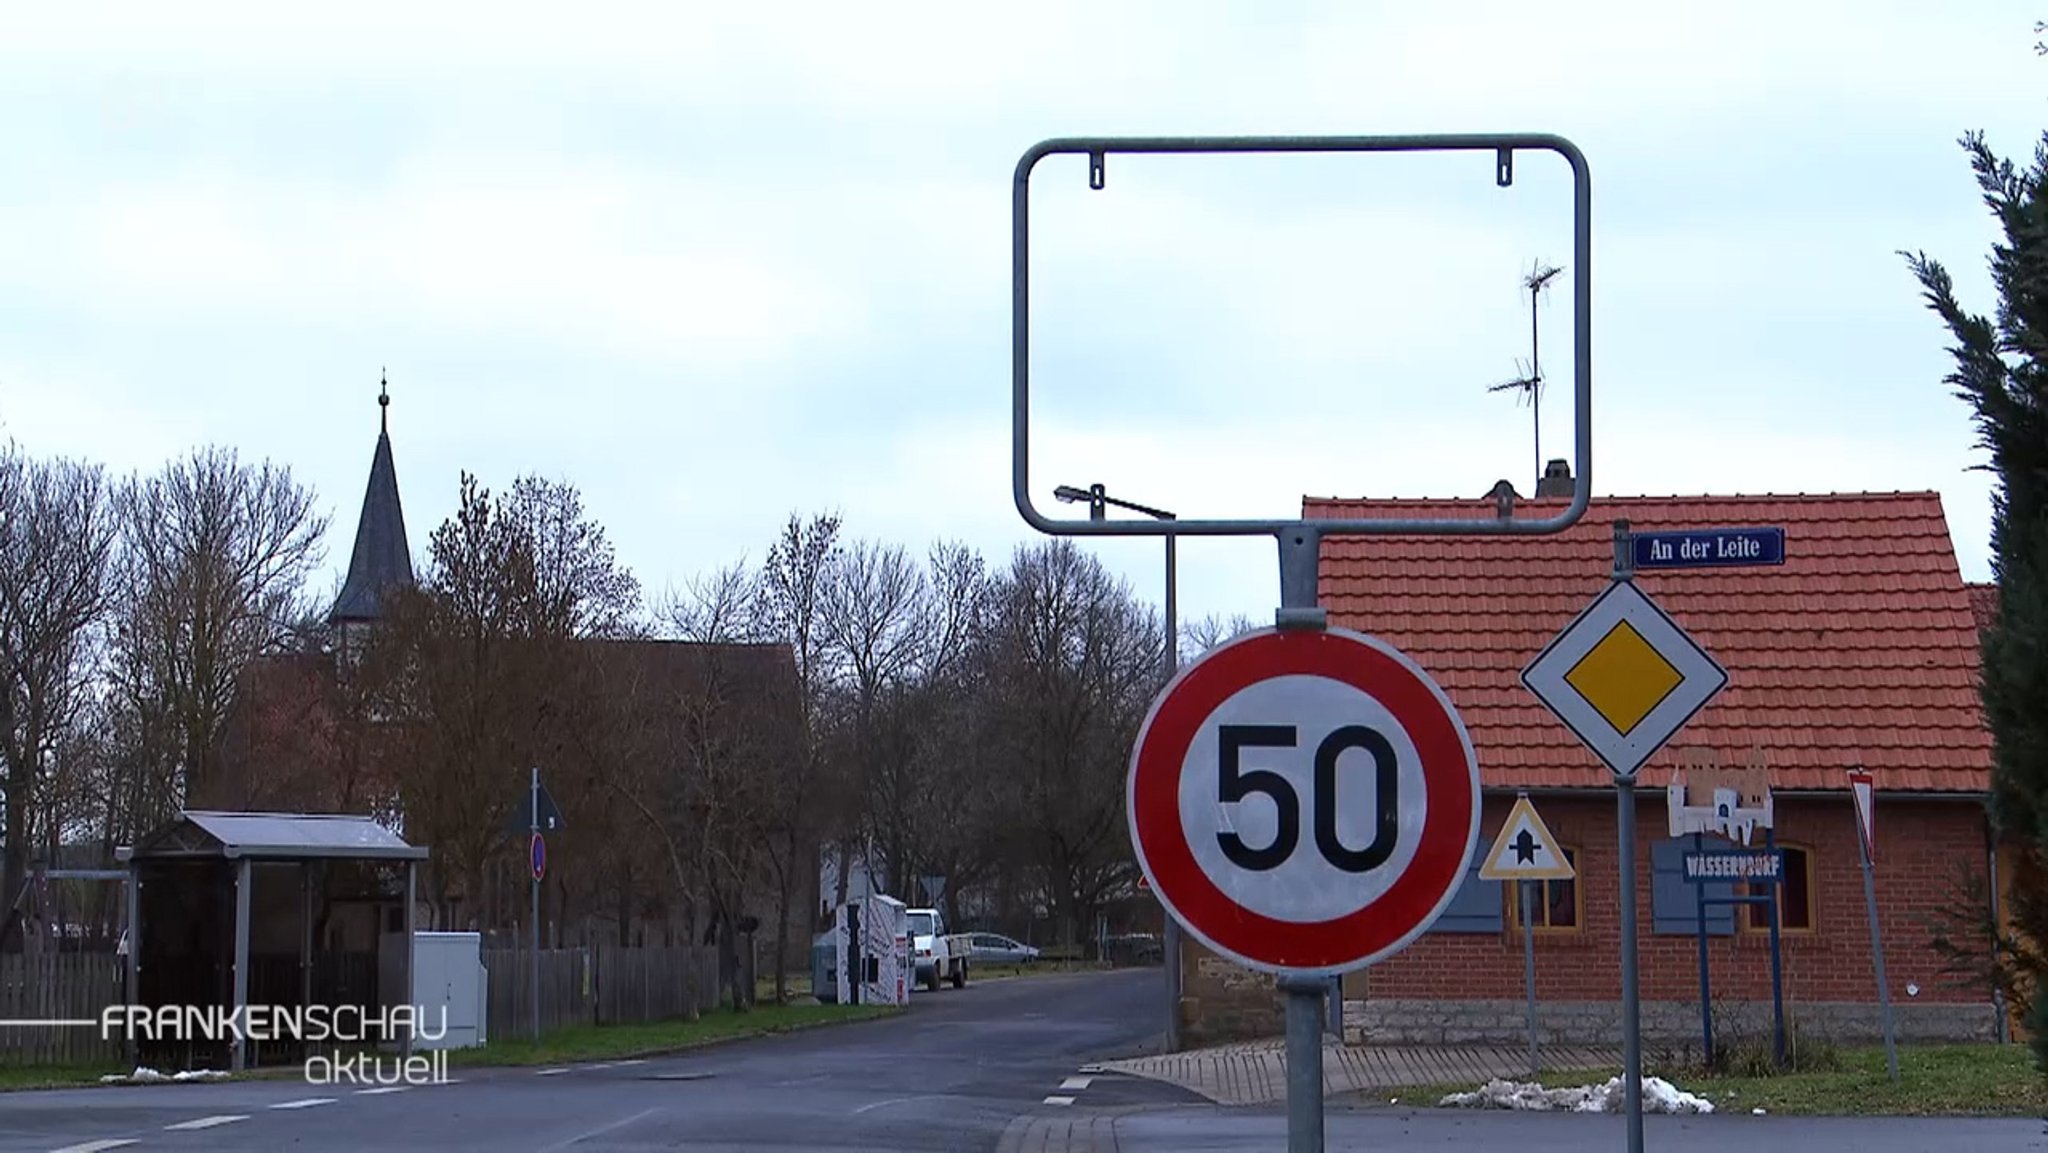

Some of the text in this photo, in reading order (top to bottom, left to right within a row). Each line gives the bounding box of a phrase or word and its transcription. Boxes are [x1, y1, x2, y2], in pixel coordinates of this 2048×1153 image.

[1650, 535, 1761, 560] An der Leite
[1216, 725, 1398, 873] 50
